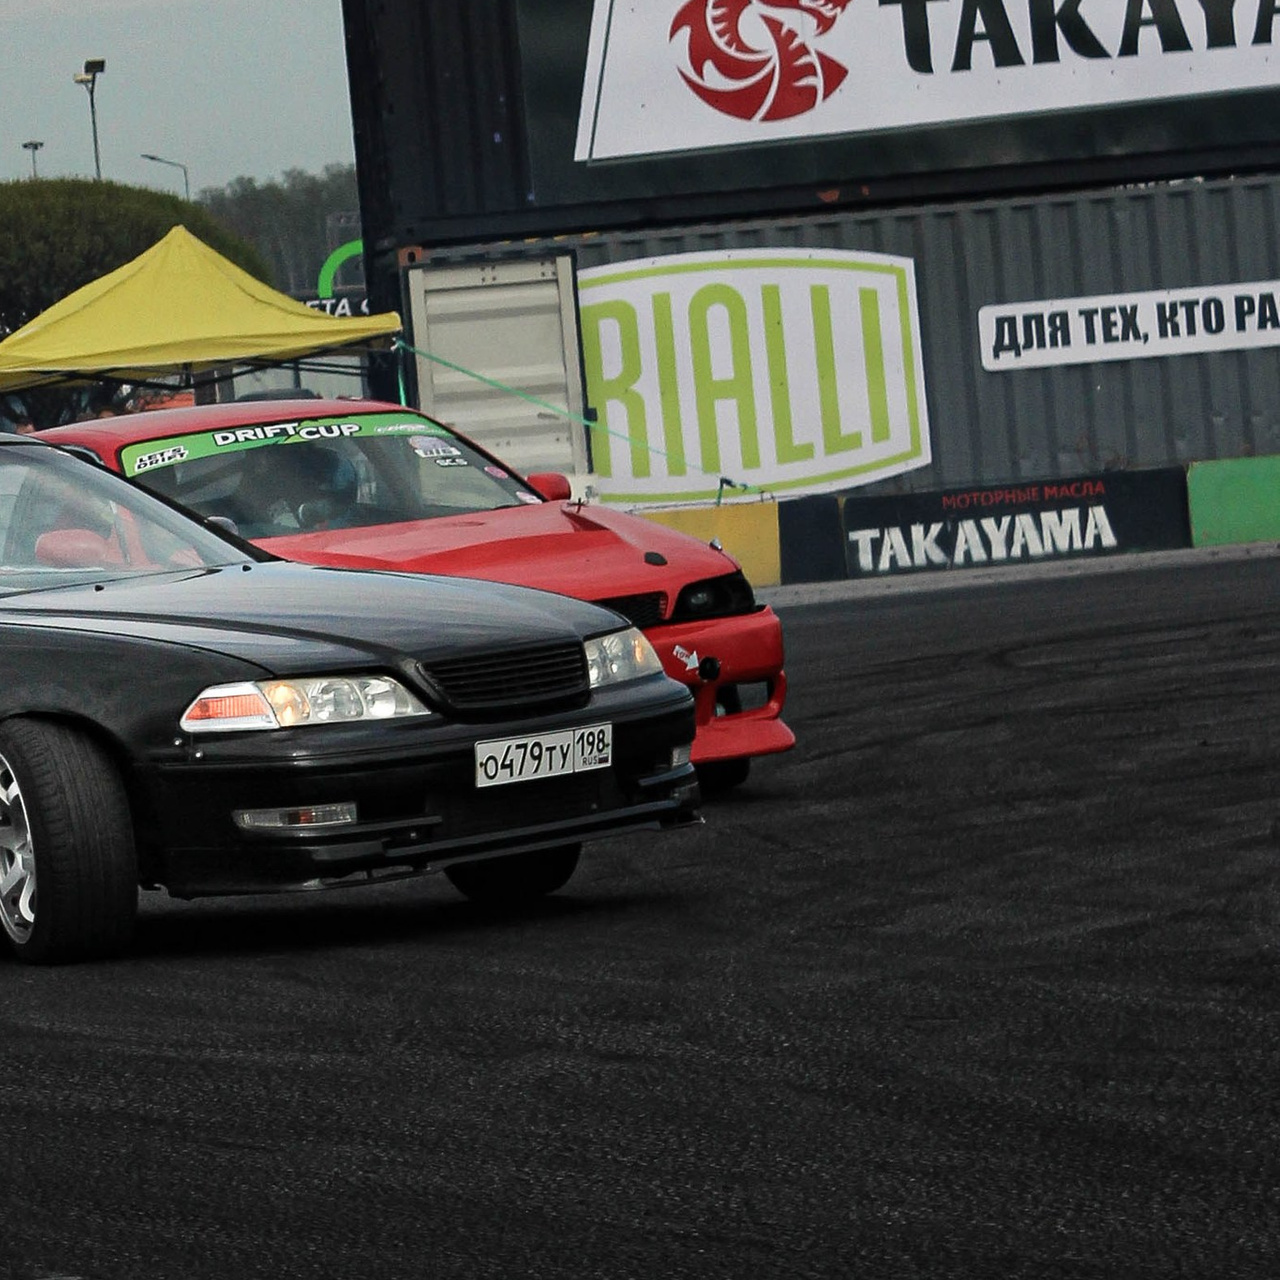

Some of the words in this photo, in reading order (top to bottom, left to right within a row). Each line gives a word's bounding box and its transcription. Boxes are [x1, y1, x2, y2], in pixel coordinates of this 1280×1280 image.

[993, 310, 1071, 360] ДЛЯ
[1078, 303, 1150, 345] ТЕХ,
[1155, 297, 1226, 339] КТО
[1234, 291, 1280, 332] РА
[214, 423, 299, 446] DRIFT
[297, 423, 361, 440] CUP
[136, 452, 187, 469] DRIFT
[138, 447, 183, 463] LET'S
[942, 487, 1039, 509] МОТОРНЫЕ
[1044, 480, 1106, 501] МАСЛА
[848, 505, 1118, 571] TAKAYAMA
[576, 728, 607, 757] 198
[582, 754, 598, 766] RUS
